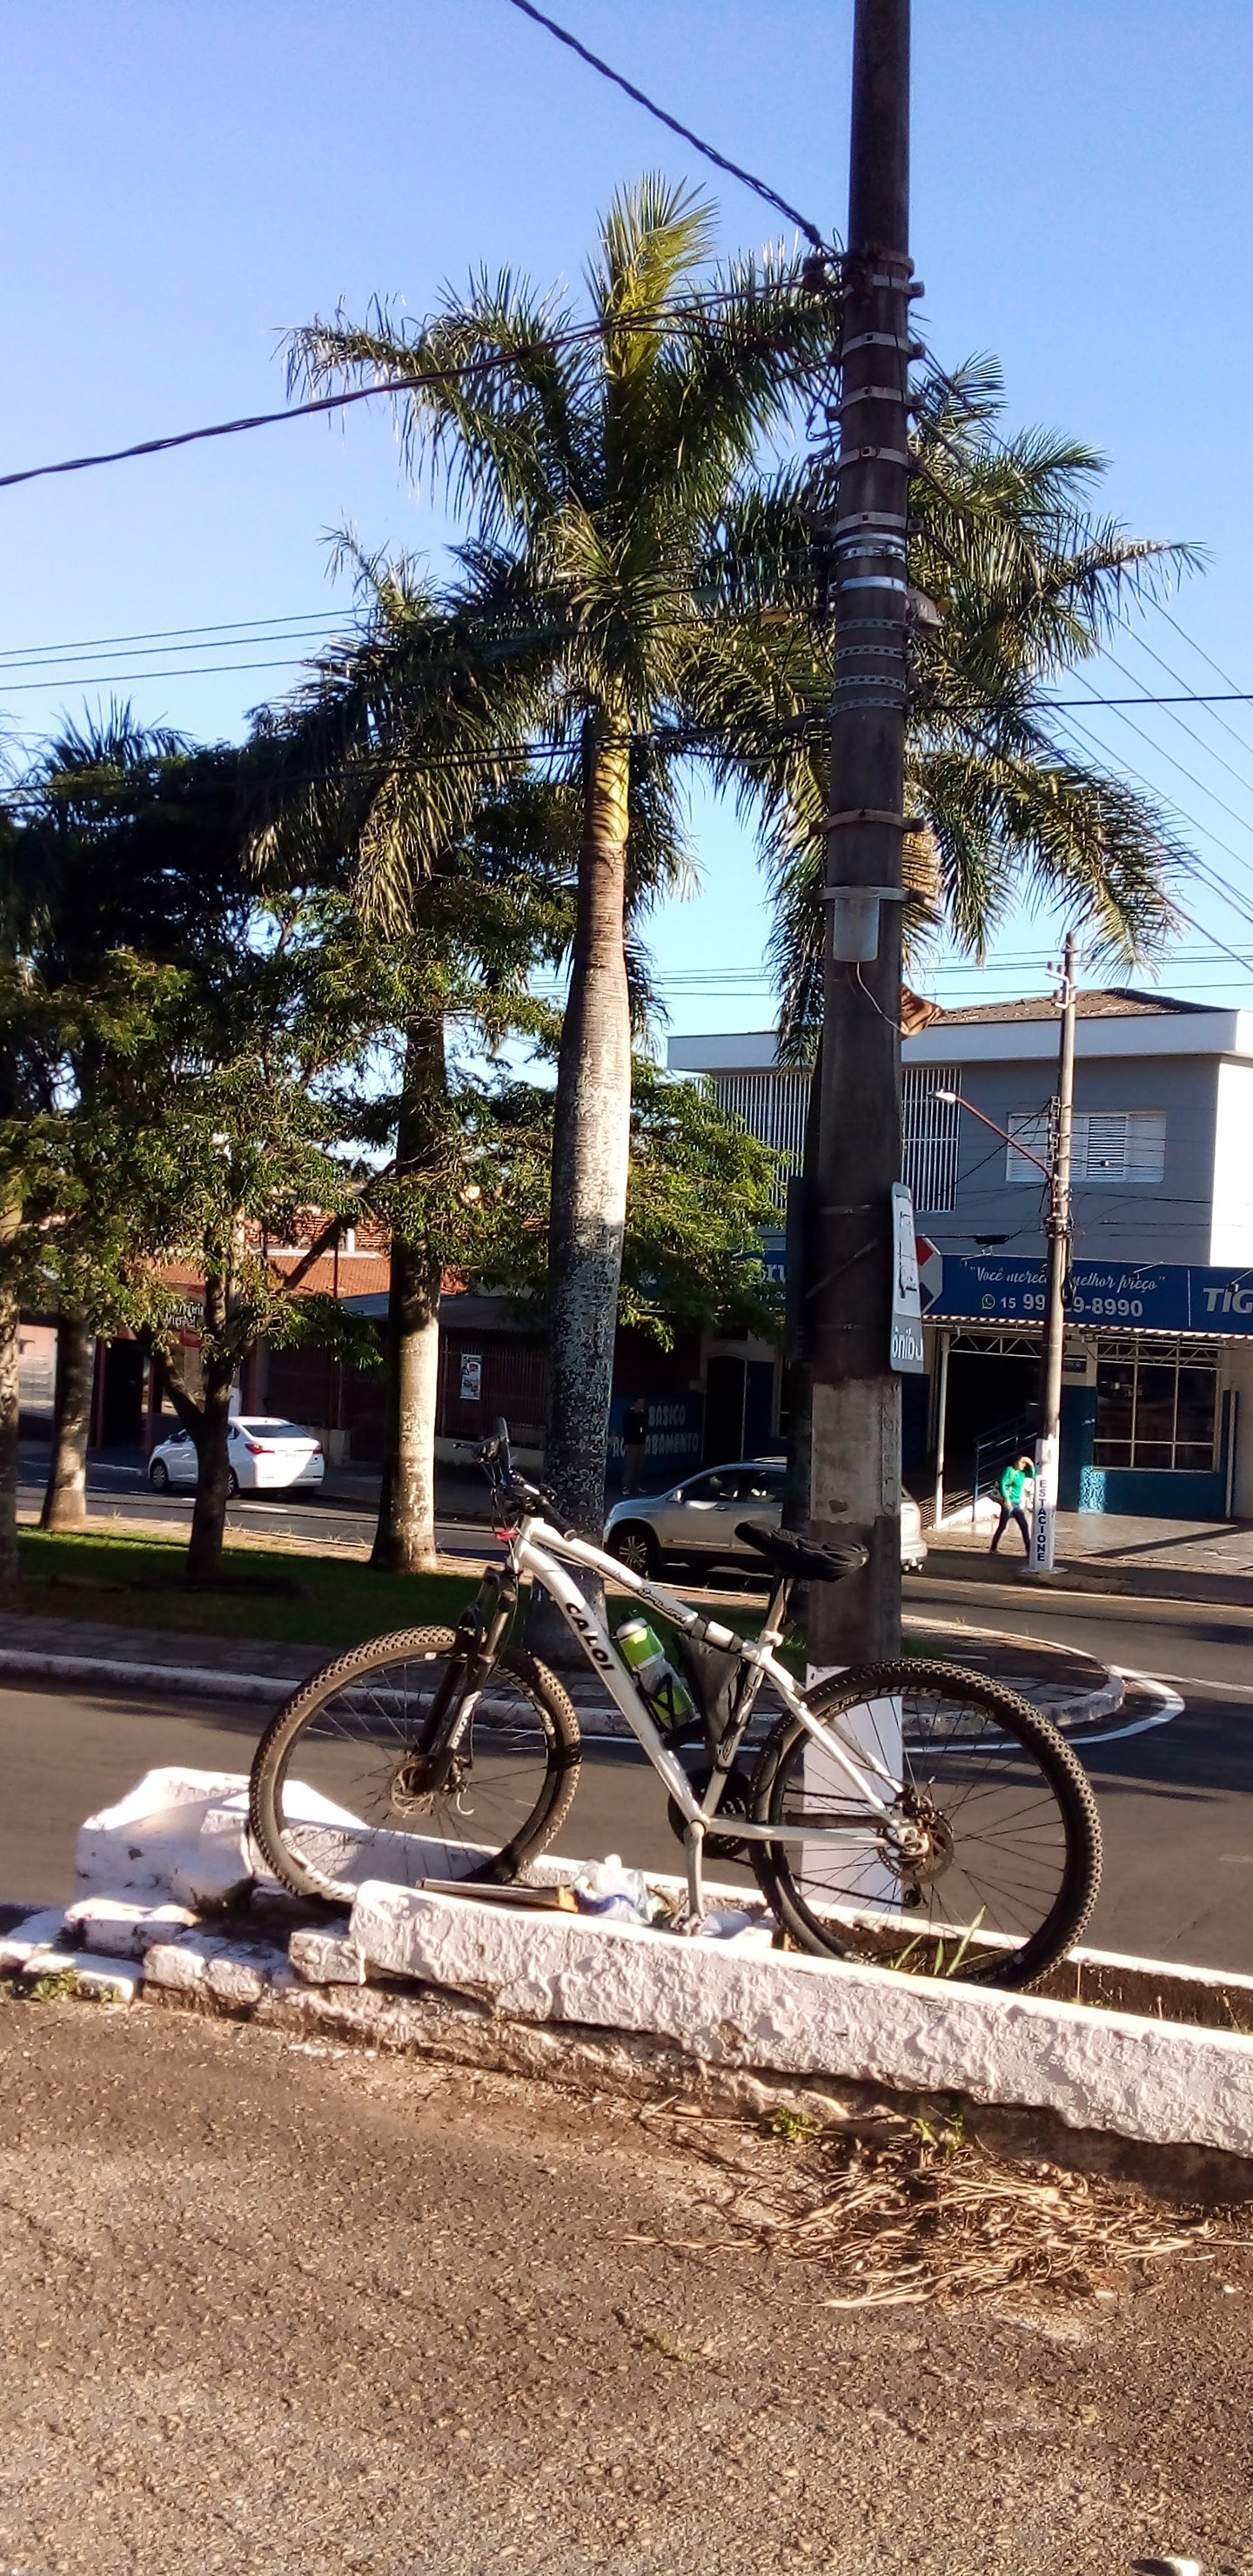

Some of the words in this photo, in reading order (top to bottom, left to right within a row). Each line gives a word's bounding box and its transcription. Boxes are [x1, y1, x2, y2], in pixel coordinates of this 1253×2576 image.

[1006, 1271, 1048, 1285] merec
[1001, 1296, 1016, 1309] 15
[1022, 1292, 1143, 1318] 999-8990
[1203, 1287, 1253, 1314] TIG
[645, 1432, 700, 1456] ABAMENTO
[1036, 1479, 1048, 1562] ESTACIONE
[565, 1602, 616, 1671] CALOI
